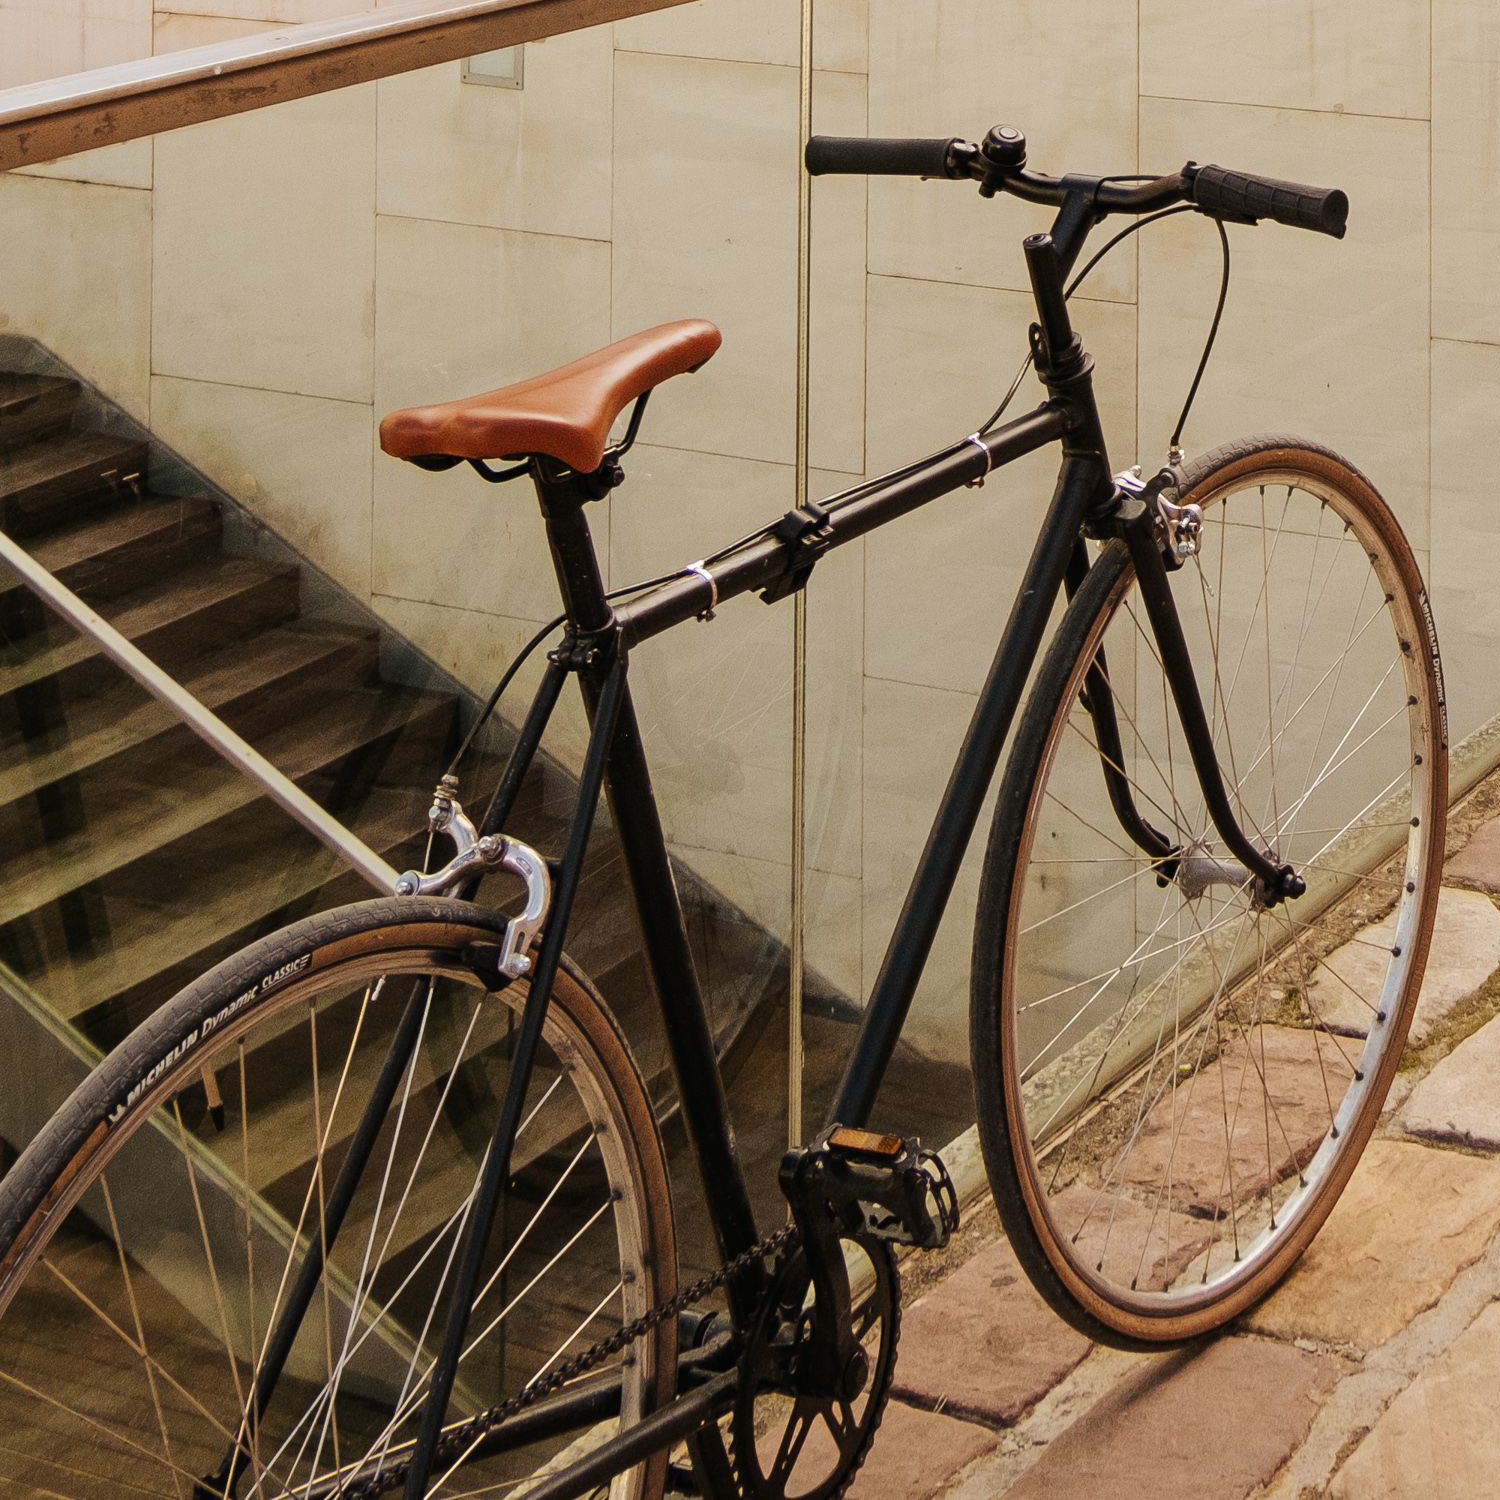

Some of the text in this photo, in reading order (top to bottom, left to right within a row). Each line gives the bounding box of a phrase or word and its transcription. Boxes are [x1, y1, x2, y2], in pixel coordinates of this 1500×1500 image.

[1421, 602, 1439, 656] MICHELIN
[1432, 657, 1445, 703] Dynamic
[127, 958, 303, 1104] MICHELIN Dynamic CLASSIC
